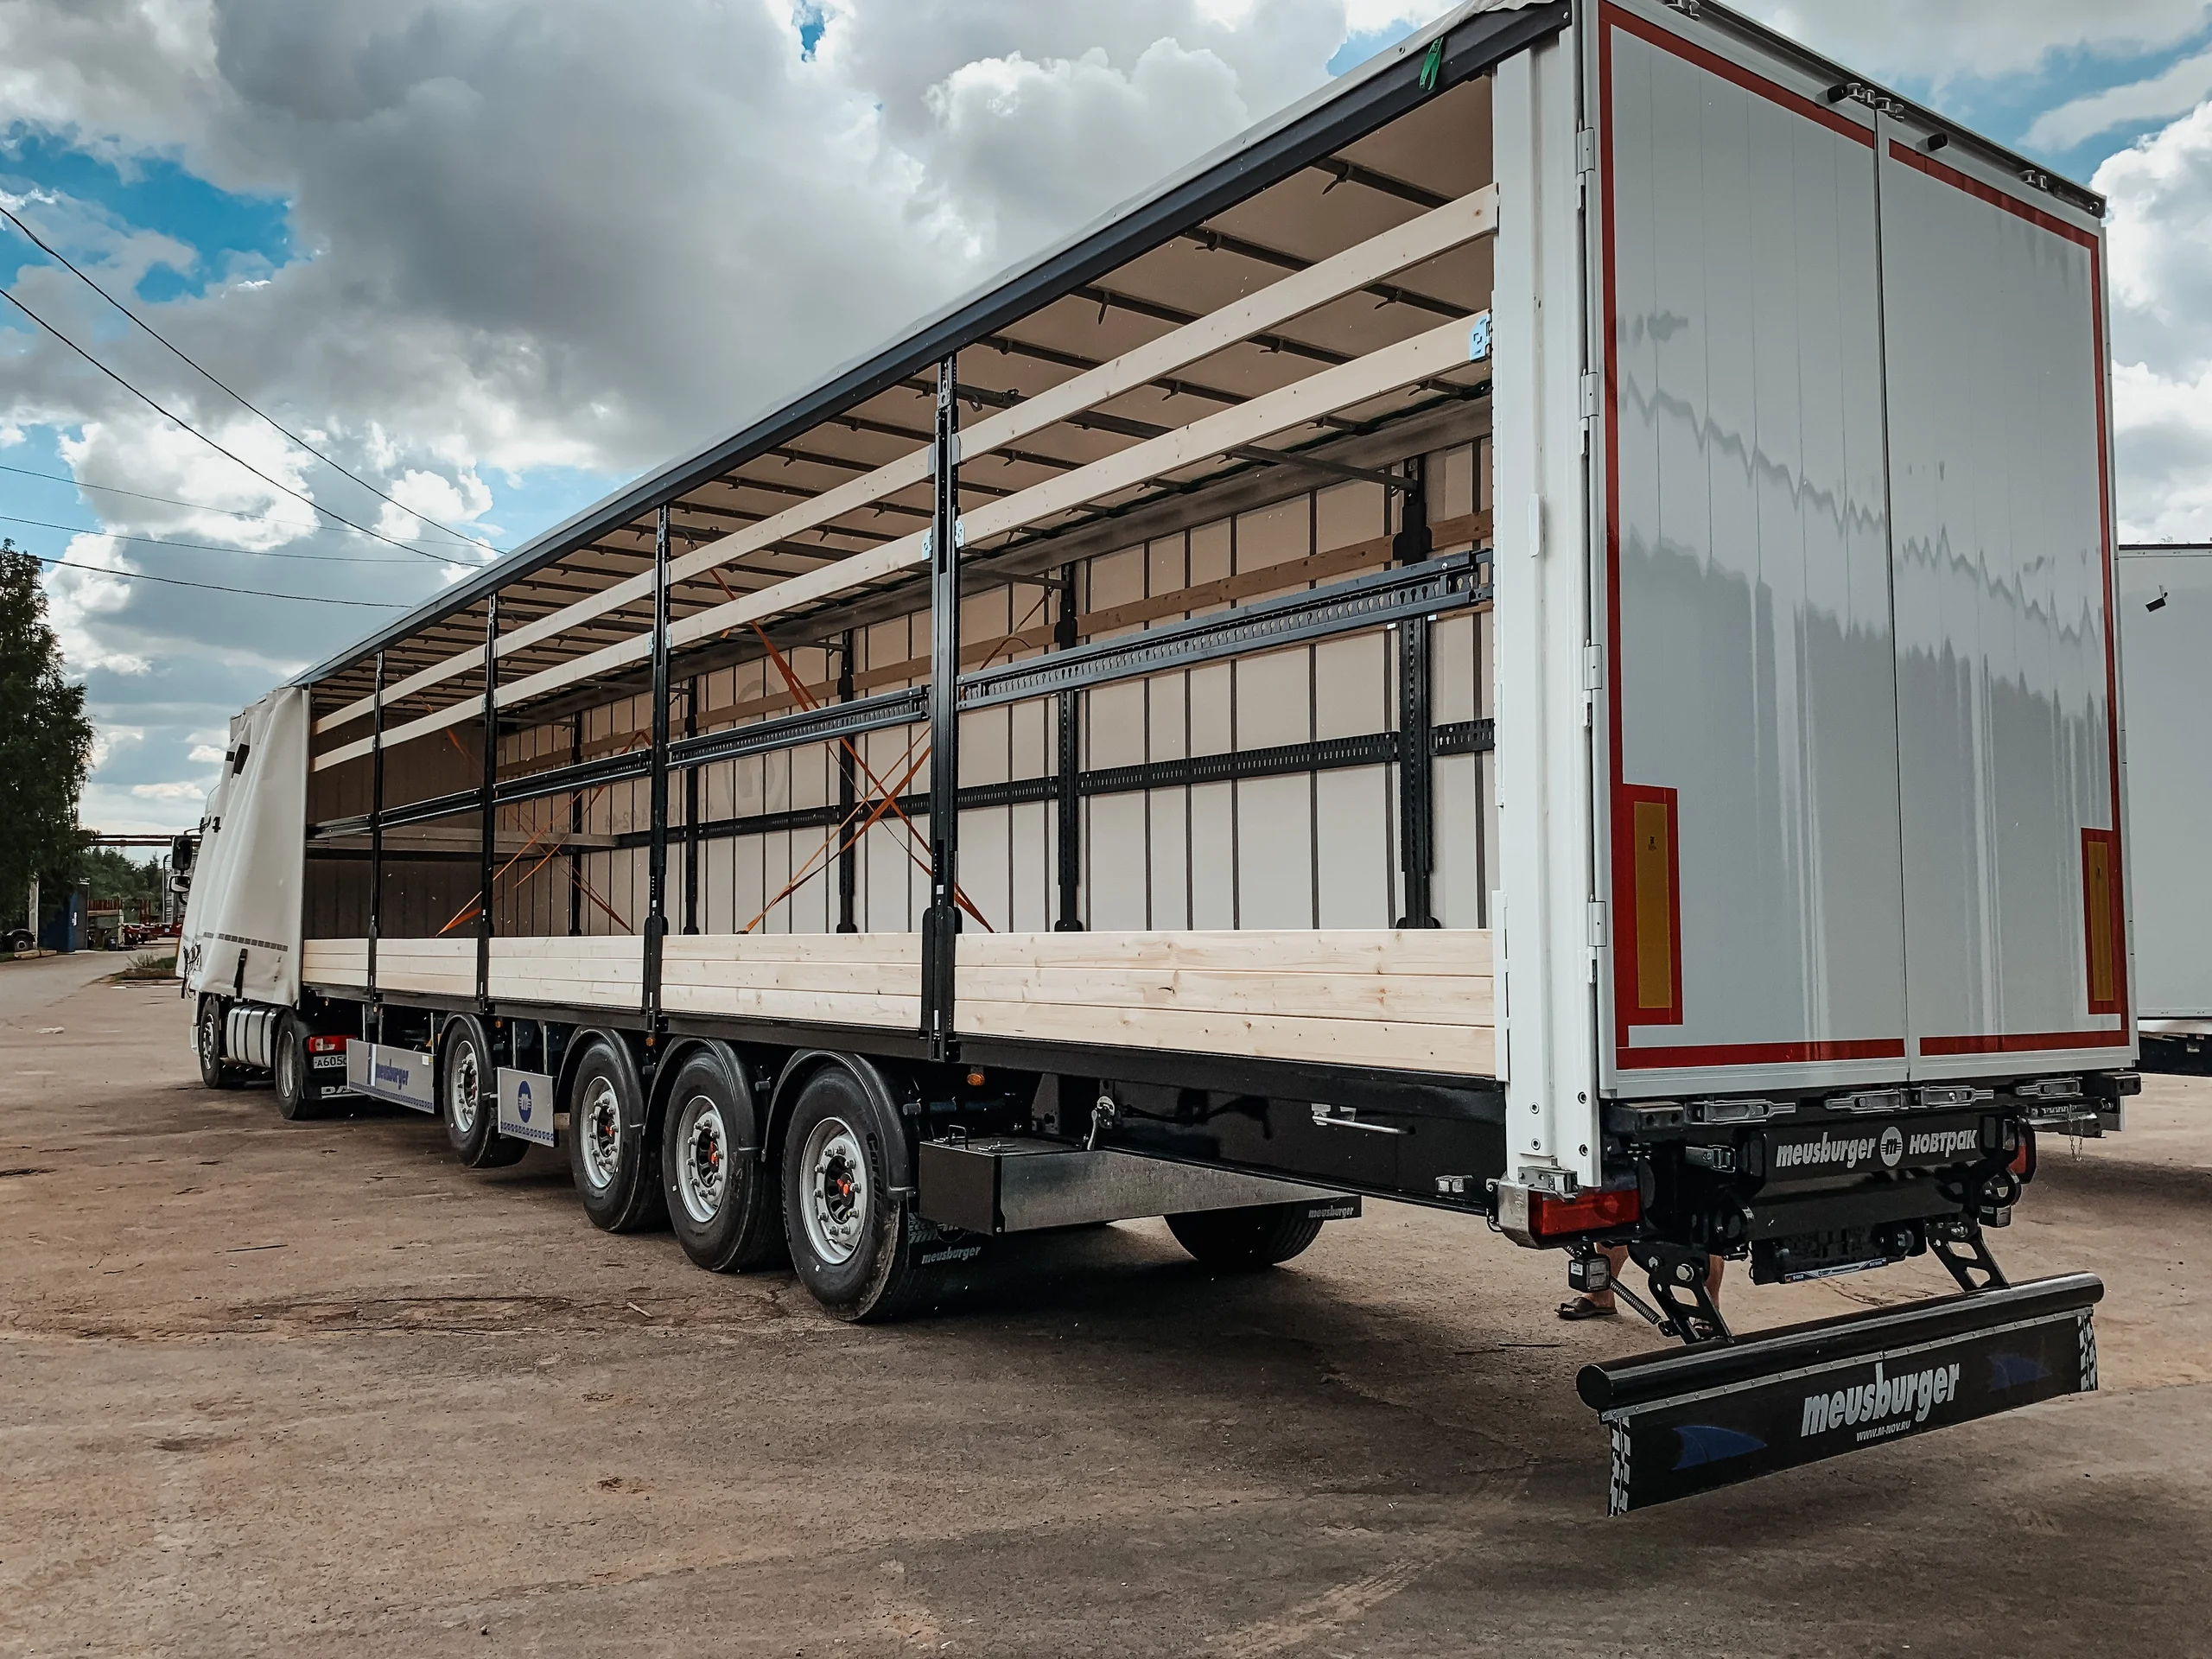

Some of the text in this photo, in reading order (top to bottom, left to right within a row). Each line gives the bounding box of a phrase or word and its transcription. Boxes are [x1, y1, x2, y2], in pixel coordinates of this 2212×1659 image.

[1776, 1131, 1877, 1168] meusburger
[1308, 1205, 1354, 1218] meusburger
[921, 1246, 982, 1265] meusburger
[1801, 1362, 1961, 1438] meusburger
